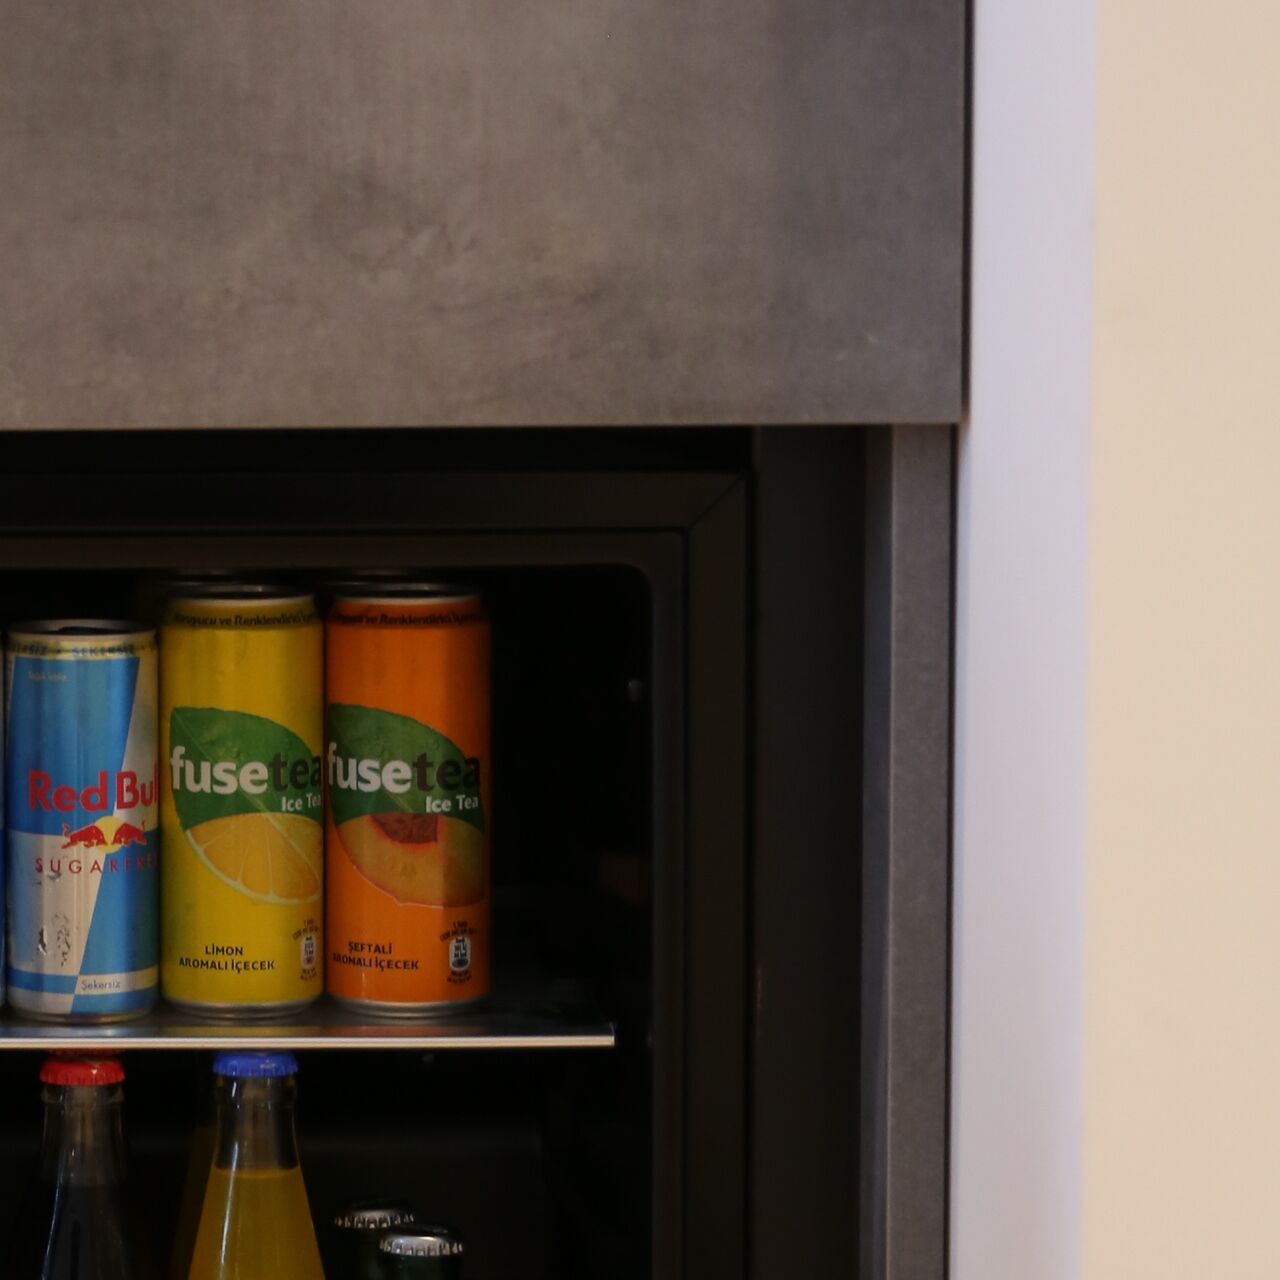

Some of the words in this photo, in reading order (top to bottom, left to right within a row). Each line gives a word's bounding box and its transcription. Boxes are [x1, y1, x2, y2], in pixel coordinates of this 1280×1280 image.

[28, 768, 108, 813] Red
[116, 764, 160, 810] Bul
[281, 796, 303, 812] Ice
[425, 795, 452, 813] Ice
[456, 793, 480, 811] Tea
[205, 944, 243, 956] LİMON
[347, 941, 392, 954] ŞEFTALİ
[179, 957, 228, 971] AROMALI
[231, 959, 275, 973] İÇECEK
[375, 956, 419, 971] İÇECEK
